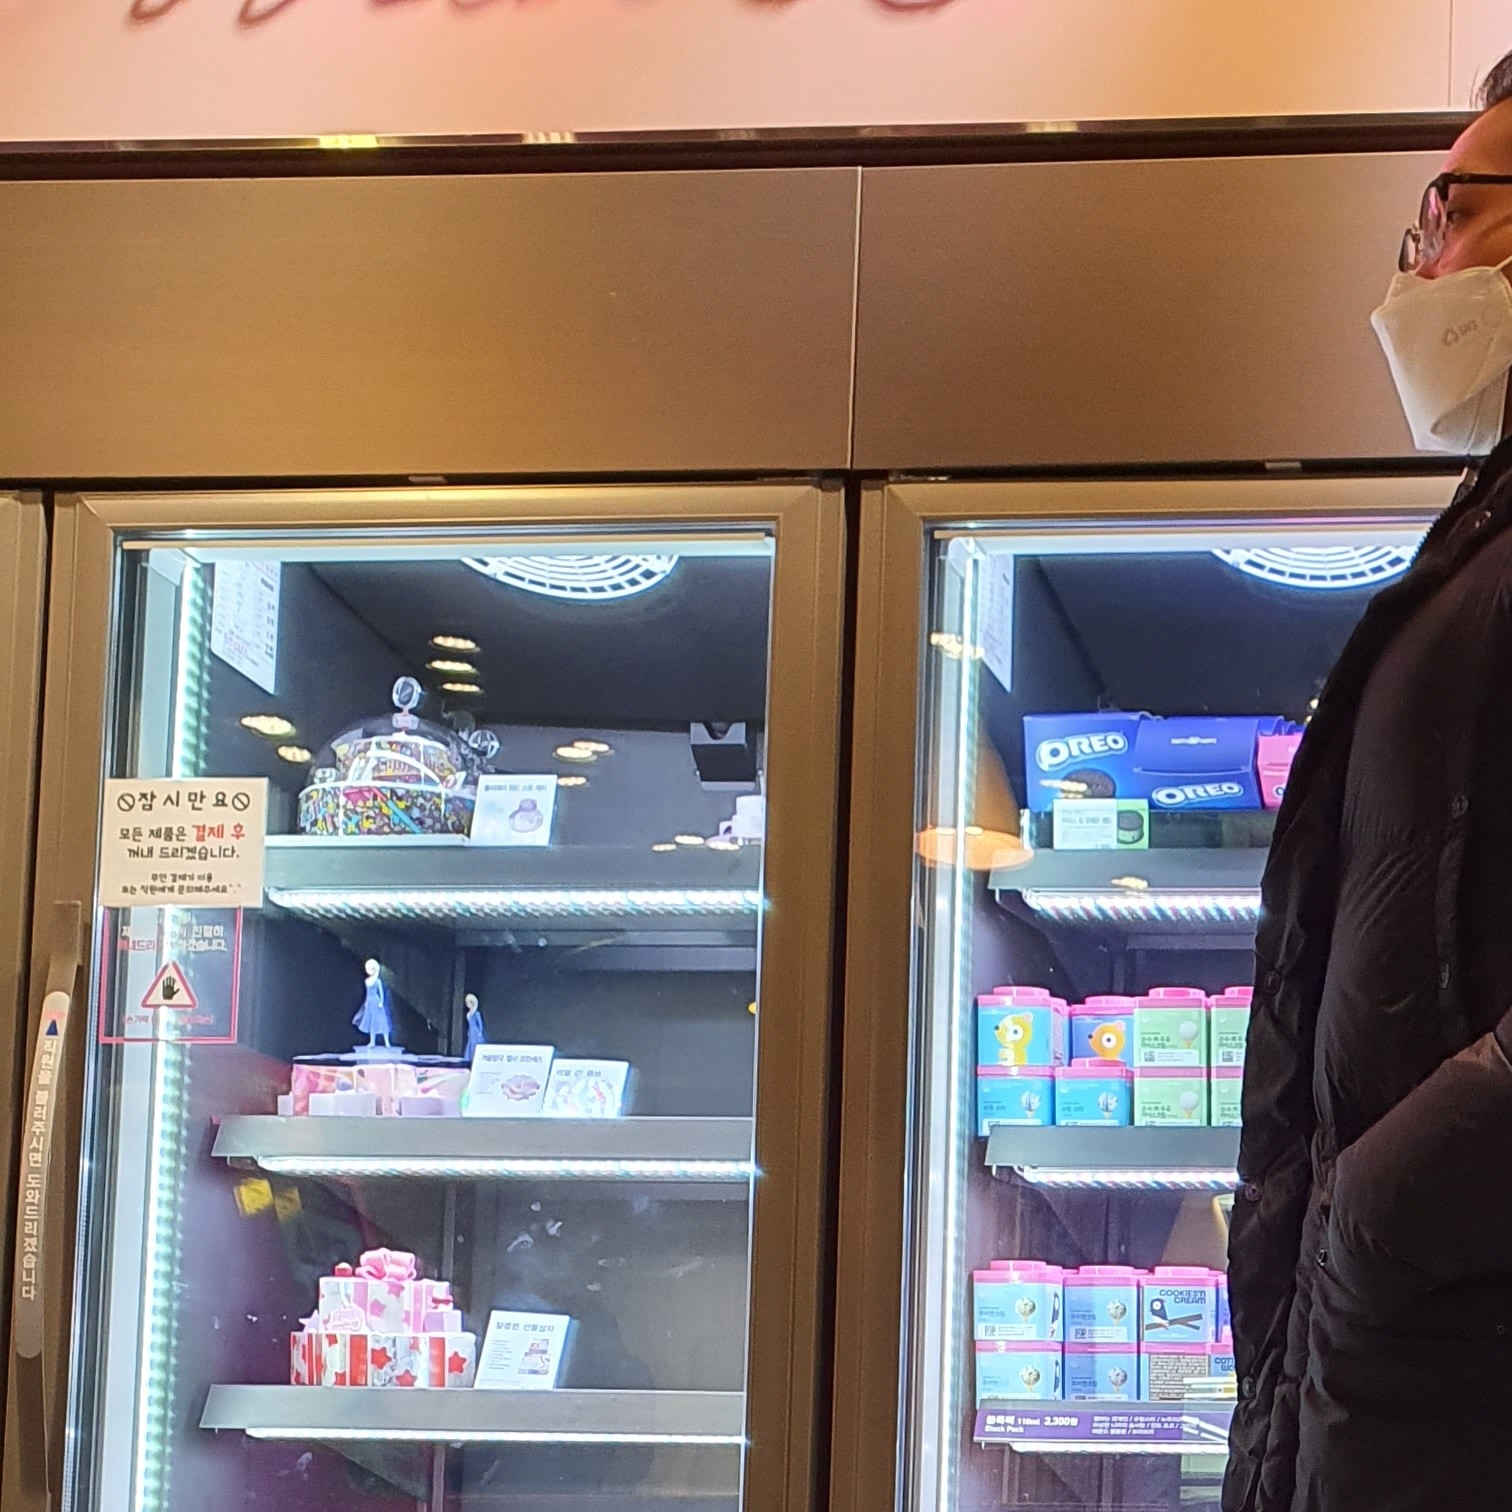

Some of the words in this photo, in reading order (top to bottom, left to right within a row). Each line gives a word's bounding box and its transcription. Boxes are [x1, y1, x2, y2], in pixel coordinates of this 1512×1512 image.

[1039, 733, 1126, 769] OREO
[1154, 783, 1241, 805] OREO
[119, 827, 143, 842] 모든
[148, 826, 187, 842] 제품은
[192, 823, 225, 842] 결제
[231, 822, 246, 840] 후
[127, 846, 154, 859] 꺼내
[158, 845, 240, 861] 드리겠습니다.
[21, 1173, 43, 1301] 도와드리겠습니다
